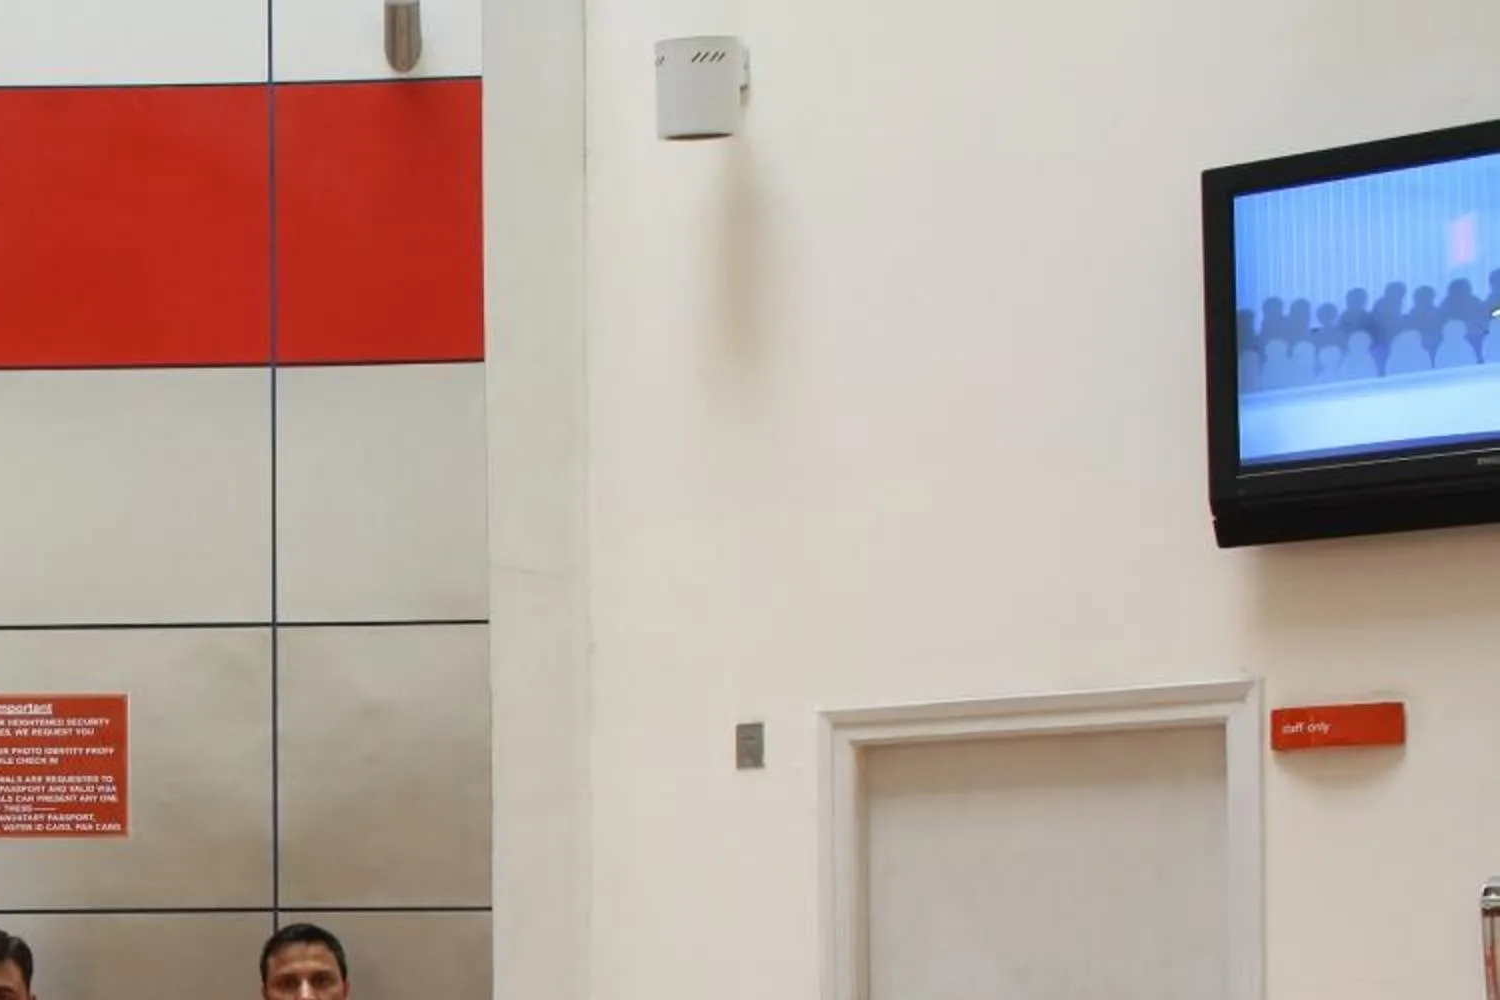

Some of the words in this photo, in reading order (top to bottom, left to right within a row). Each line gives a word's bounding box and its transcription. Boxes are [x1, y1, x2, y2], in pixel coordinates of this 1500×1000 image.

[67, 718, 109, 727] SECURITY
[15, 728, 29, 737] WE
[32, 728, 74, 737] REQUEST
[77, 728, 94, 737] YOU
[1282, 722, 1304, 734] staff
[1308, 722, 1330, 734] only
[12, 747, 42, 756] PHOTO
[16, 757, 47, 765] CHECK
[25, 775, 43, 784] ARE
[45, 775, 99, 784] REQUESTED
[101, 775, 113, 784] TO
[0, 785, 46, 793] PASSPORT
[49, 785, 67, 793] AND
[15, 794, 34, 803] CAN
[80, 794, 98, 803] ANY
